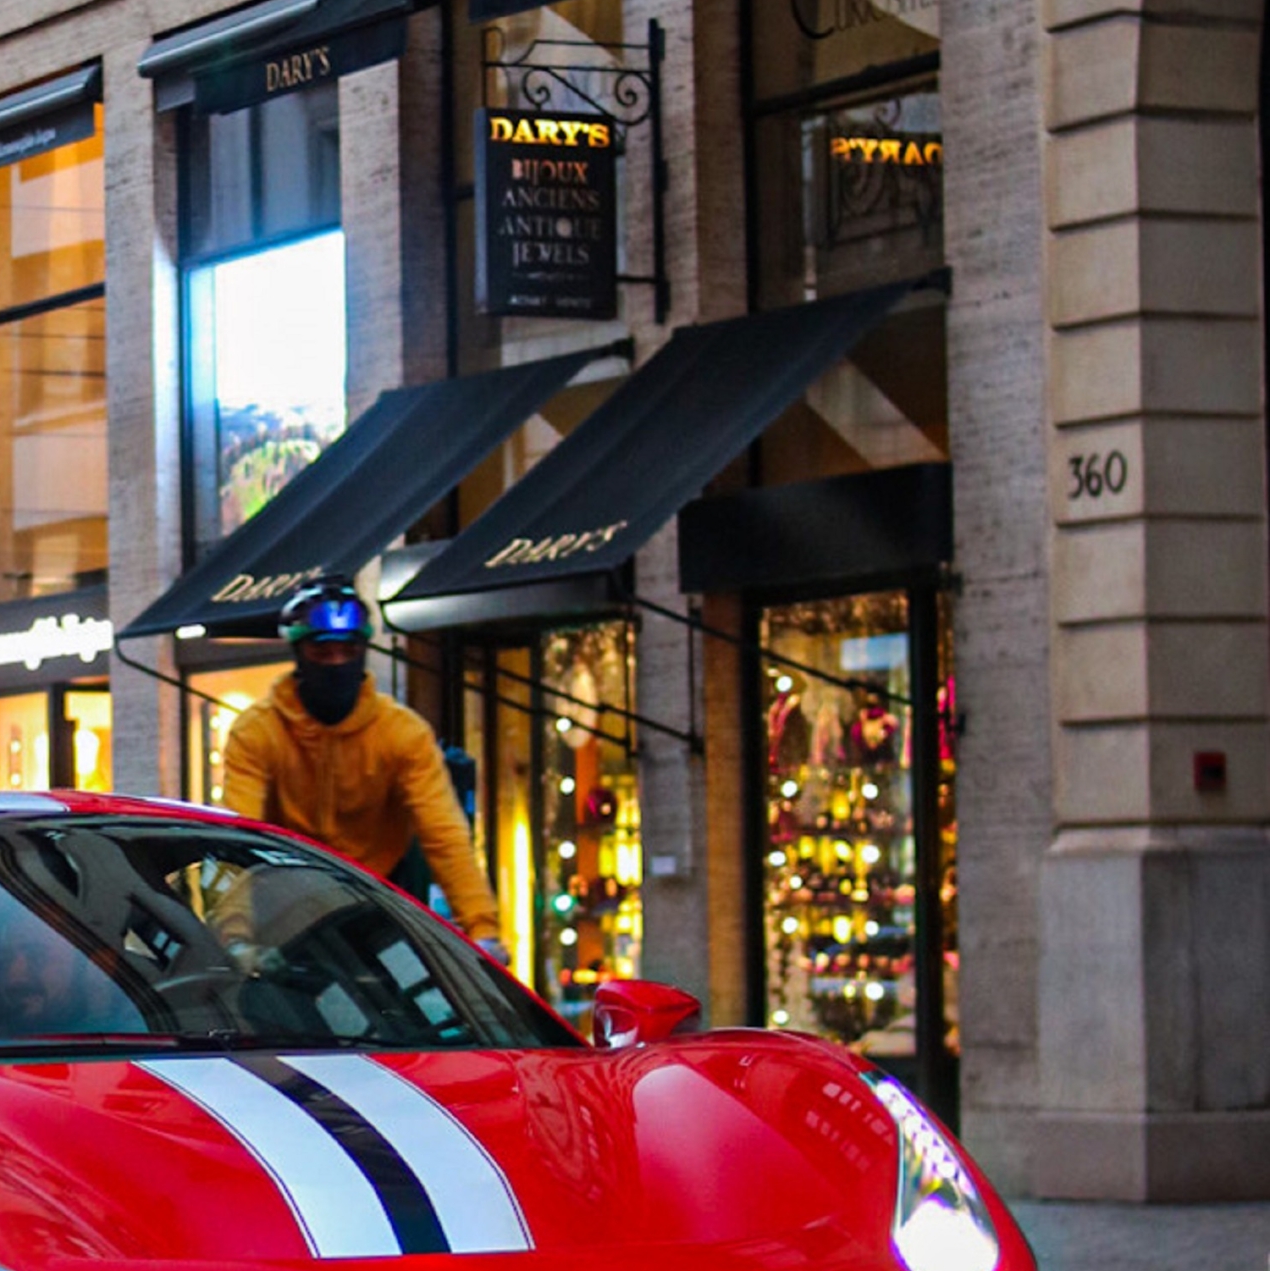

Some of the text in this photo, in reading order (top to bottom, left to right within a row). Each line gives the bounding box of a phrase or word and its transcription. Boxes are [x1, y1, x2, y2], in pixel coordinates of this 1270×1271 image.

[266, 46, 330, 93] DARY'S
[490, 116, 611, 148] DARY'S
[511, 158, 589, 187] BIJOUX
[501, 185, 601, 210] ANCIENS
[498, 214, 602, 240] ANTIQUE
[512, 240, 590, 268] JEWELS
[1068, 449, 1128, 501] 360
[484, 519, 628, 568] DARY'S
